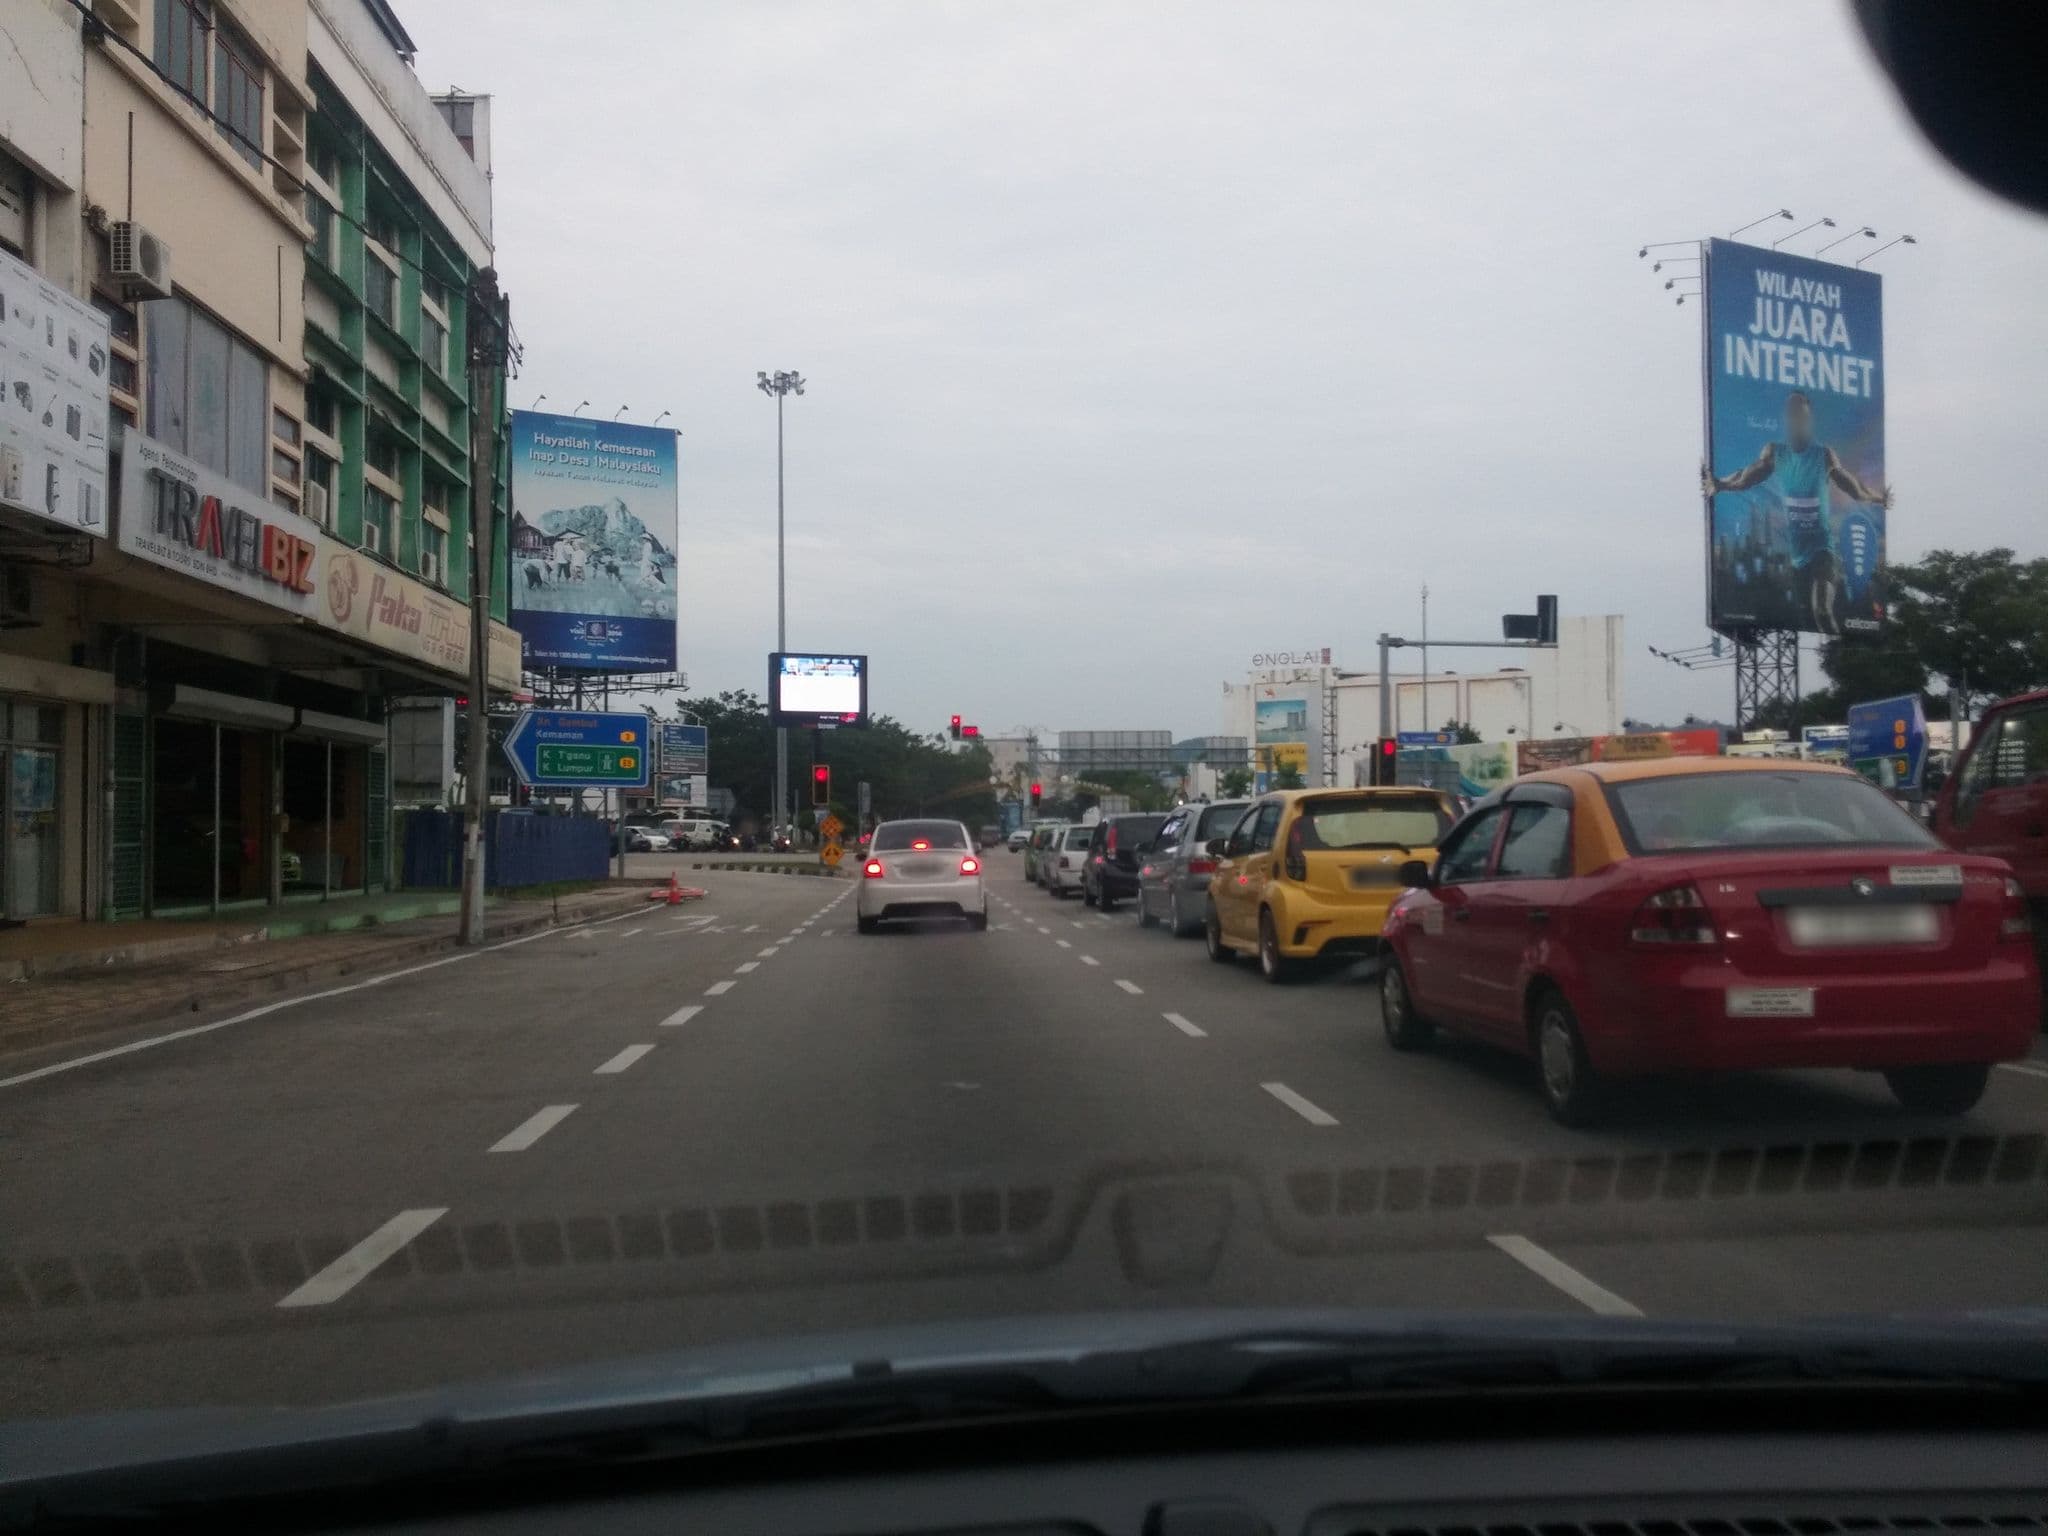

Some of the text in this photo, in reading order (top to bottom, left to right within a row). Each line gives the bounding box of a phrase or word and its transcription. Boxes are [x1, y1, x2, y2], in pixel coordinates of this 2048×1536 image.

[1756, 268, 1841, 309] WILAYAH
[1748, 296, 1852, 351] JUARA
[1724, 332, 1875, 399] INTERNET
[533, 431, 657, 458] Hayatilah Kemesraan
[528, 447, 662, 476] Inap Desa 1Malaysiaku
[535, 728, 584, 740] Kemaman
[542, 750, 551, 760] K
[542, 762, 594, 773] K Lumpur
